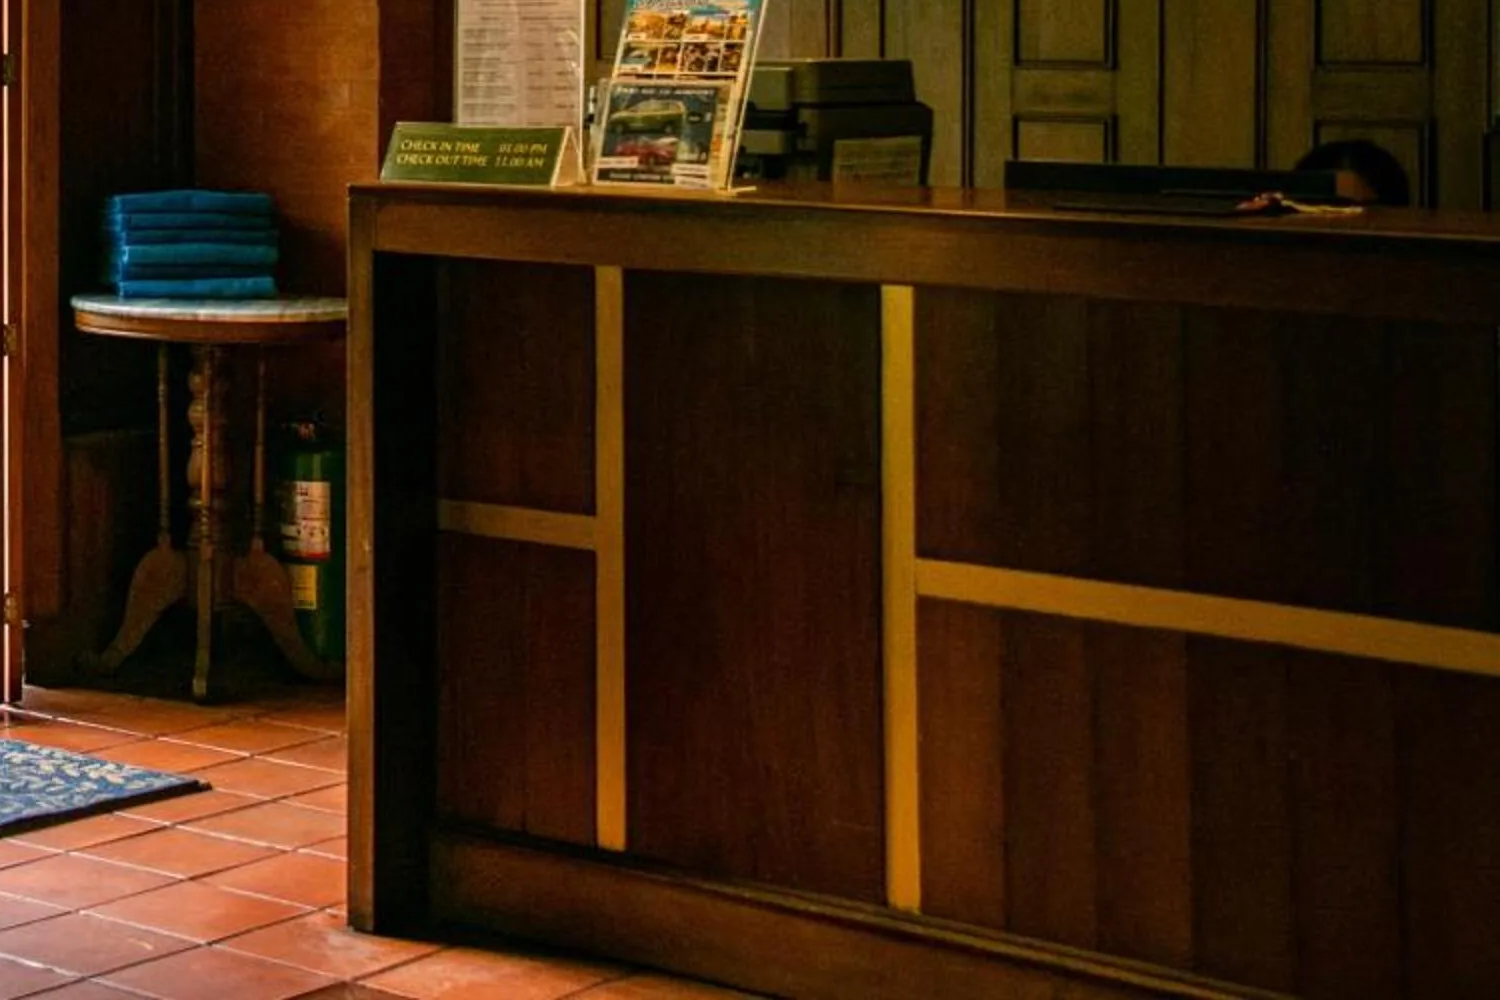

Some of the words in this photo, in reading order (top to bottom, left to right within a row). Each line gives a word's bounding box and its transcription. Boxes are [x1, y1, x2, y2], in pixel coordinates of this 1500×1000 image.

[400, 138, 438, 152] CHECK
[439, 140, 453, 152] IN
[454, 140, 481, 154] TIME
[529, 142, 548, 155] PM
[396, 153, 435, 165] CHECK
[435, 154, 461, 166] OUT
[461, 155, 489, 167] TIME
[525, 157, 545, 169] AM
